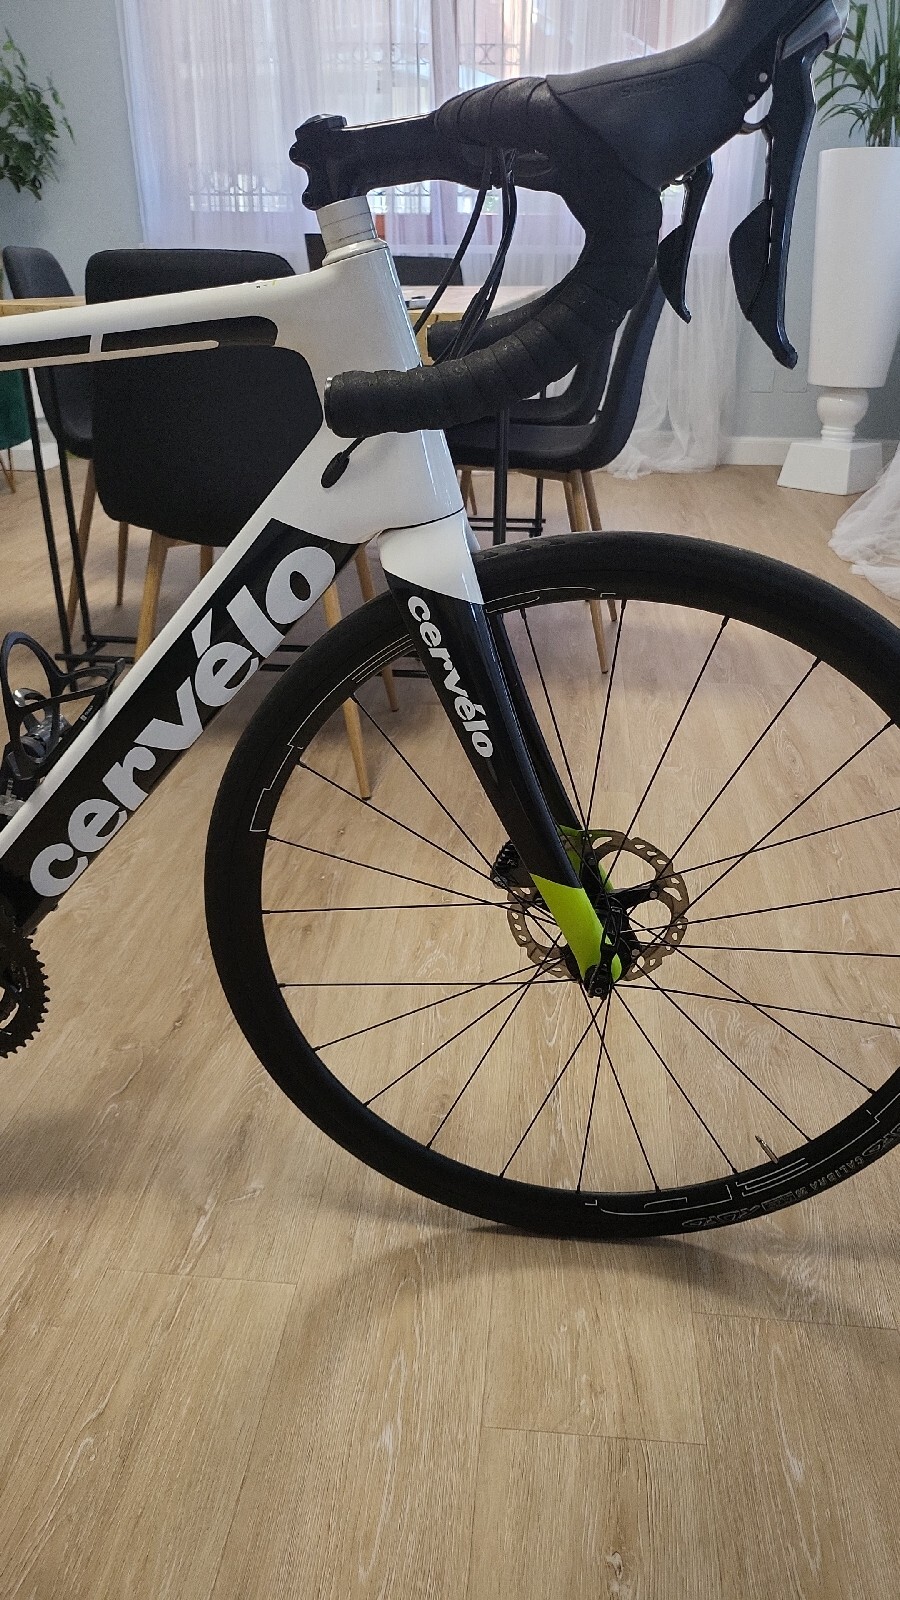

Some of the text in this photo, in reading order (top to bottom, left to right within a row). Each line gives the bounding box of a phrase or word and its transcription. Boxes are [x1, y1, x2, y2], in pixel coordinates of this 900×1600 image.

[30, 546, 336, 897] cervélo
[407, 596, 494, 758] cervélo
[809, 1155, 864, 1190] CALIBRA
